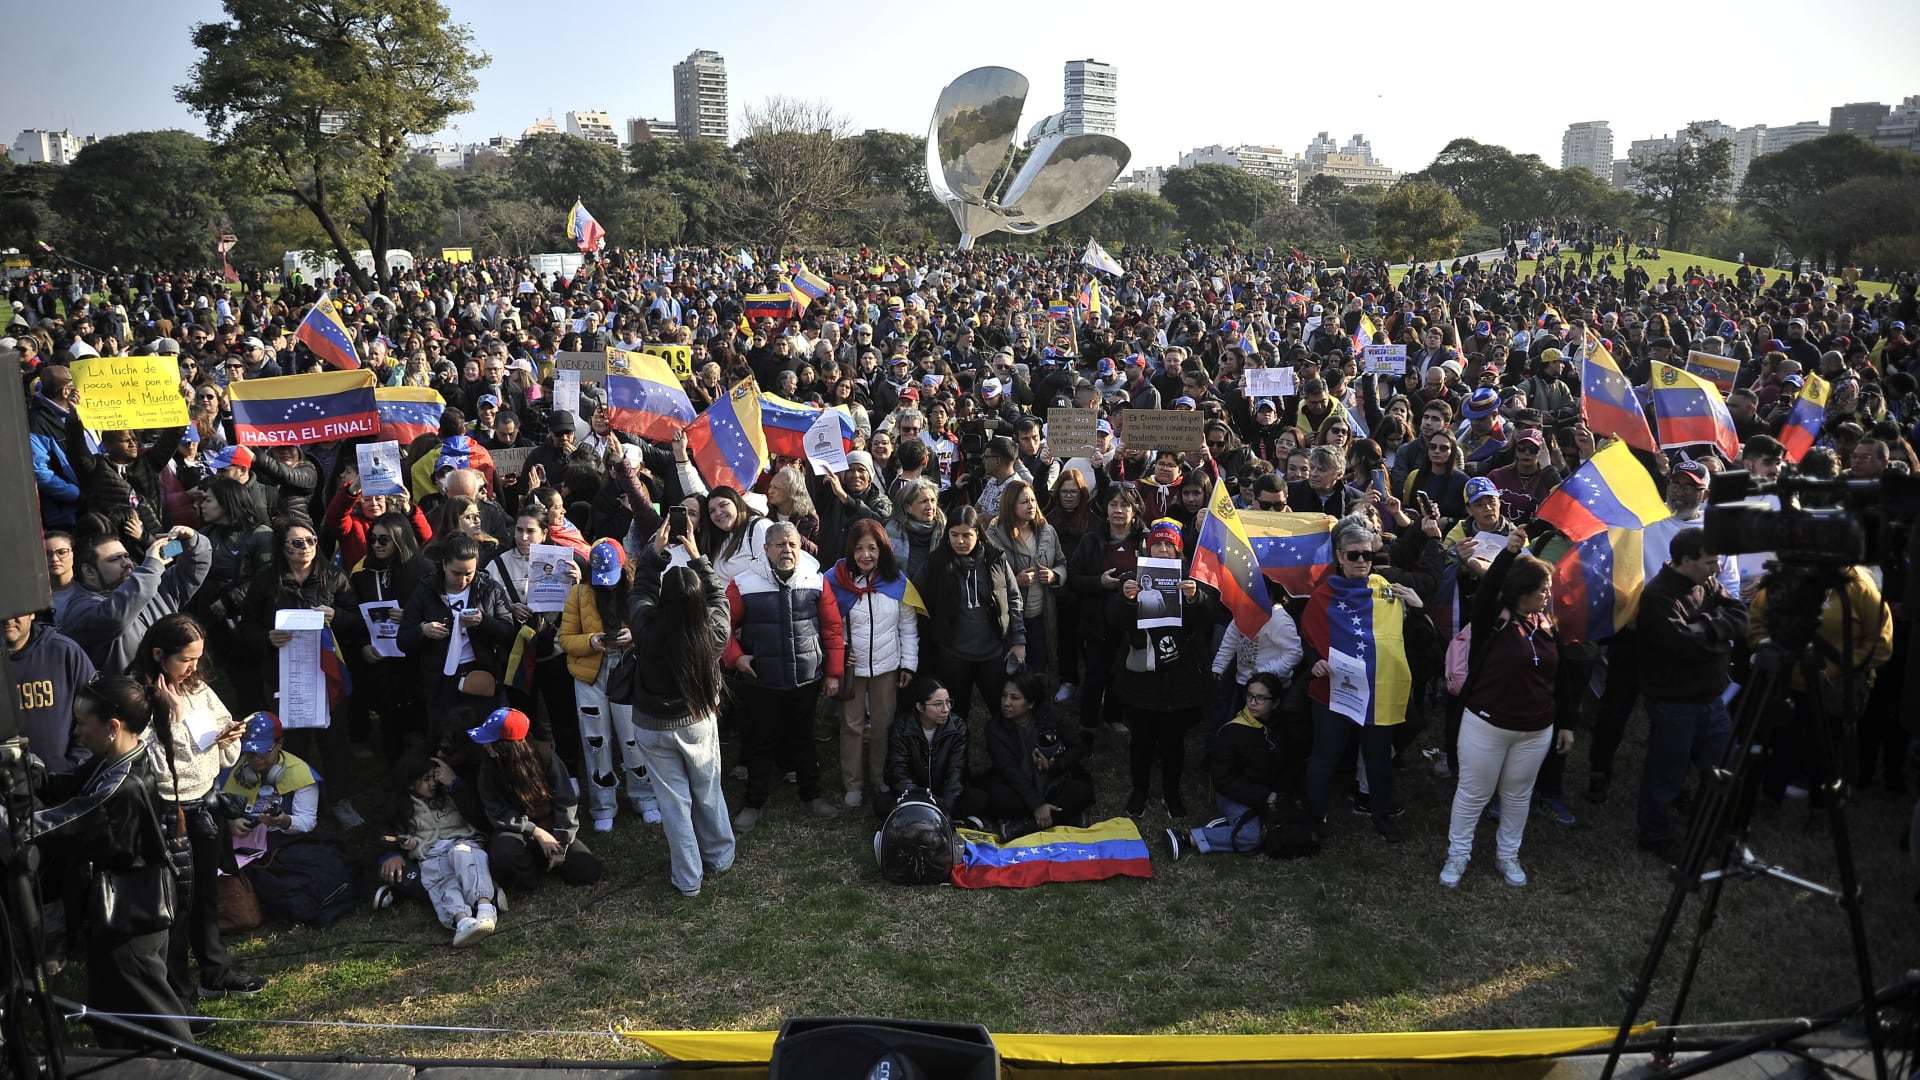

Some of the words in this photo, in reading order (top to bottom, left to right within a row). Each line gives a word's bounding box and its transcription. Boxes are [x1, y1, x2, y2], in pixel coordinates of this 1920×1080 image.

[144, 361, 157, 374] de
[560, 360, 606, 371] VENEZUELA
[83, 383, 112, 393] pocos
[164, 376, 172, 385] el
[126, 393, 136, 404] de
[241, 430, 298, 443] !HASTA
[301, 428, 321, 440] EL
[324, 418, 372, 436] FINAL!
[16, 680, 53, 709] 1969
